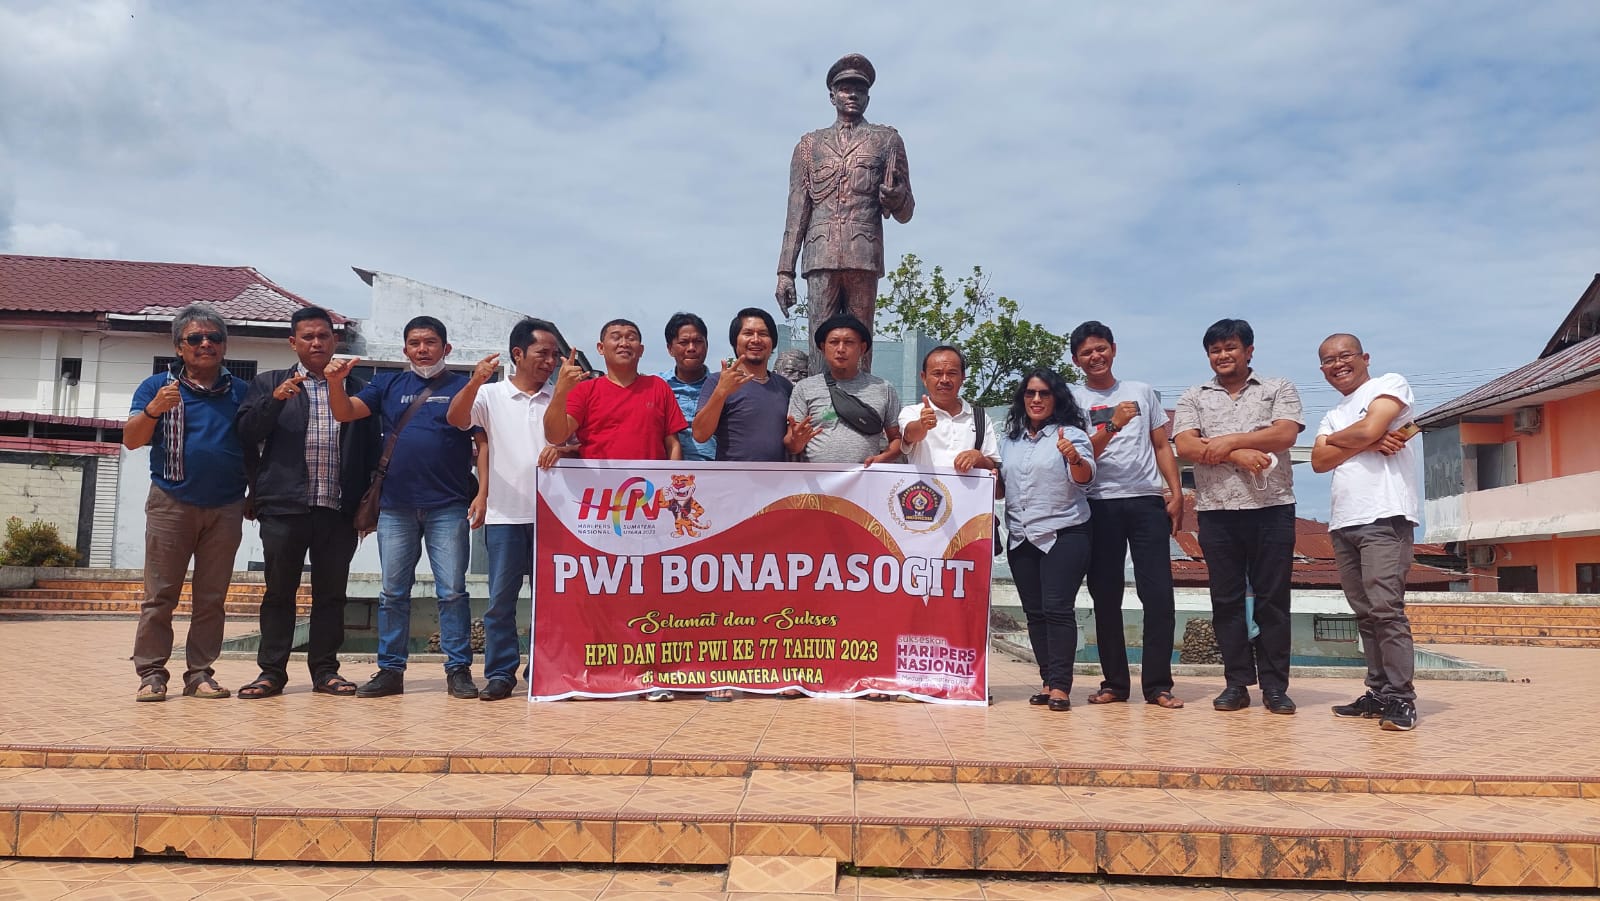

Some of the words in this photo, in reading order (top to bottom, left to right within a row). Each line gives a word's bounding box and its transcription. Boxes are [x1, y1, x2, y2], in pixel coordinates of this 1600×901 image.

[553, 553, 645, 595] PWI
[660, 553, 975, 599] BONAPASOGIT
[627, 609, 721, 634] Selamat
[723, 610, 757, 627] dan
[763, 607, 838, 630] Sukses
[898, 635, 947, 645] sukseskan
[584, 643, 617, 666] HPN
[623, 642, 656, 665] DAN
[660, 641, 694, 664] HUT
[698, 641, 728, 662] PWI
[732, 640, 755, 661] KE
[759, 638, 779, 660] 77
[783, 638, 836, 660] TAHUN
[841, 639, 879, 662] 2023
[897, 645, 934, 658] HARI
[939, 647, 976, 662] PERS
[642, 670, 654, 684] di
[658, 670, 707, 685] MEDAN
[710, 668, 779, 684] SUMATERA
[782, 667, 824, 684] UTARA
[897, 658, 974, 676] NASIONAL
